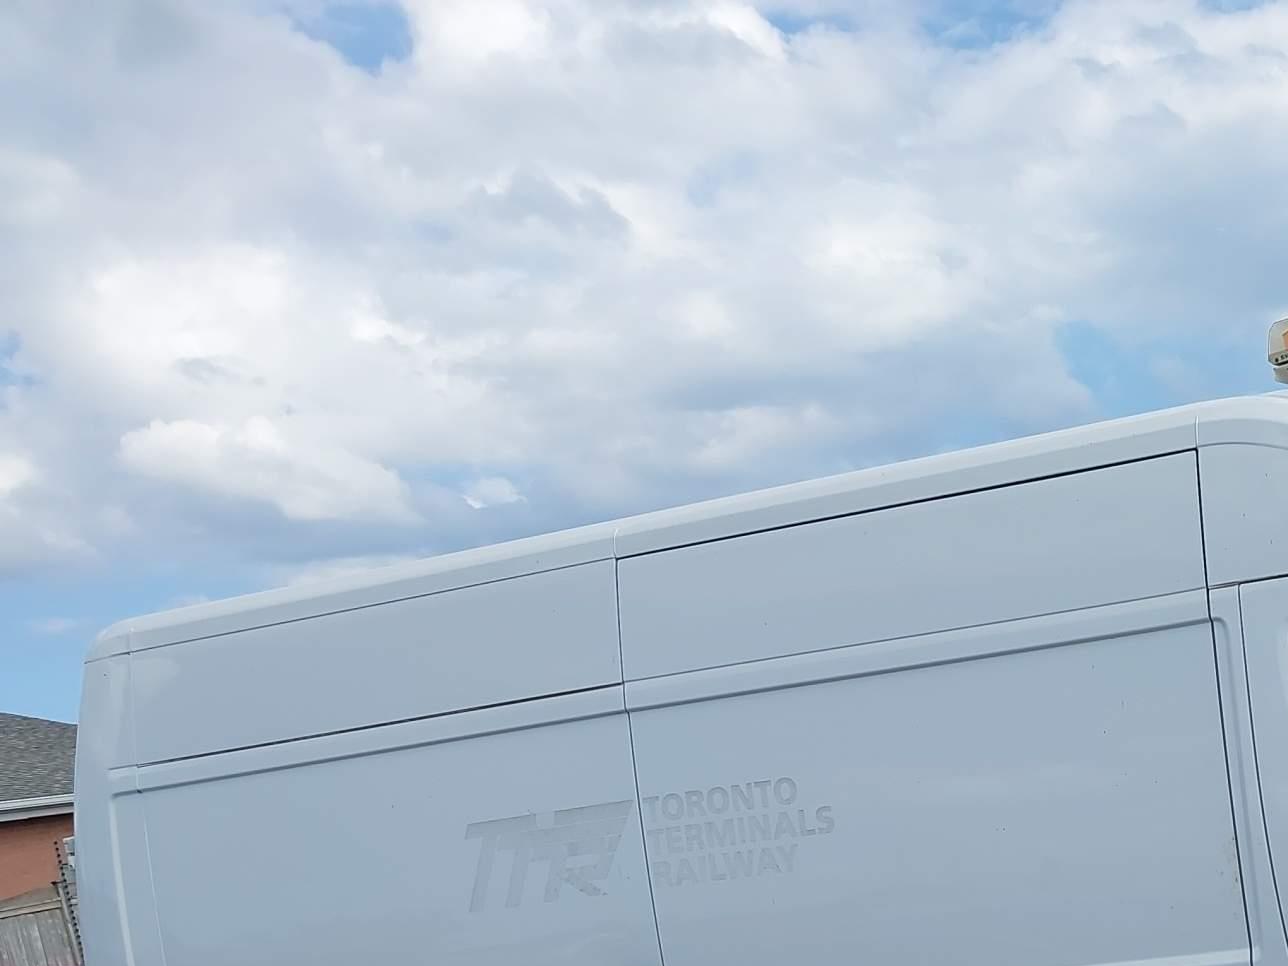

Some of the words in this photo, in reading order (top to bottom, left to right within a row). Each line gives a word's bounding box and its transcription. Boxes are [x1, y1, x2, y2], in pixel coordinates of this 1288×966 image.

[642, 777, 798, 823] TORONTO
[646, 806, 835, 857] TERMINALS
[651, 843, 798, 888] RAILWAY
